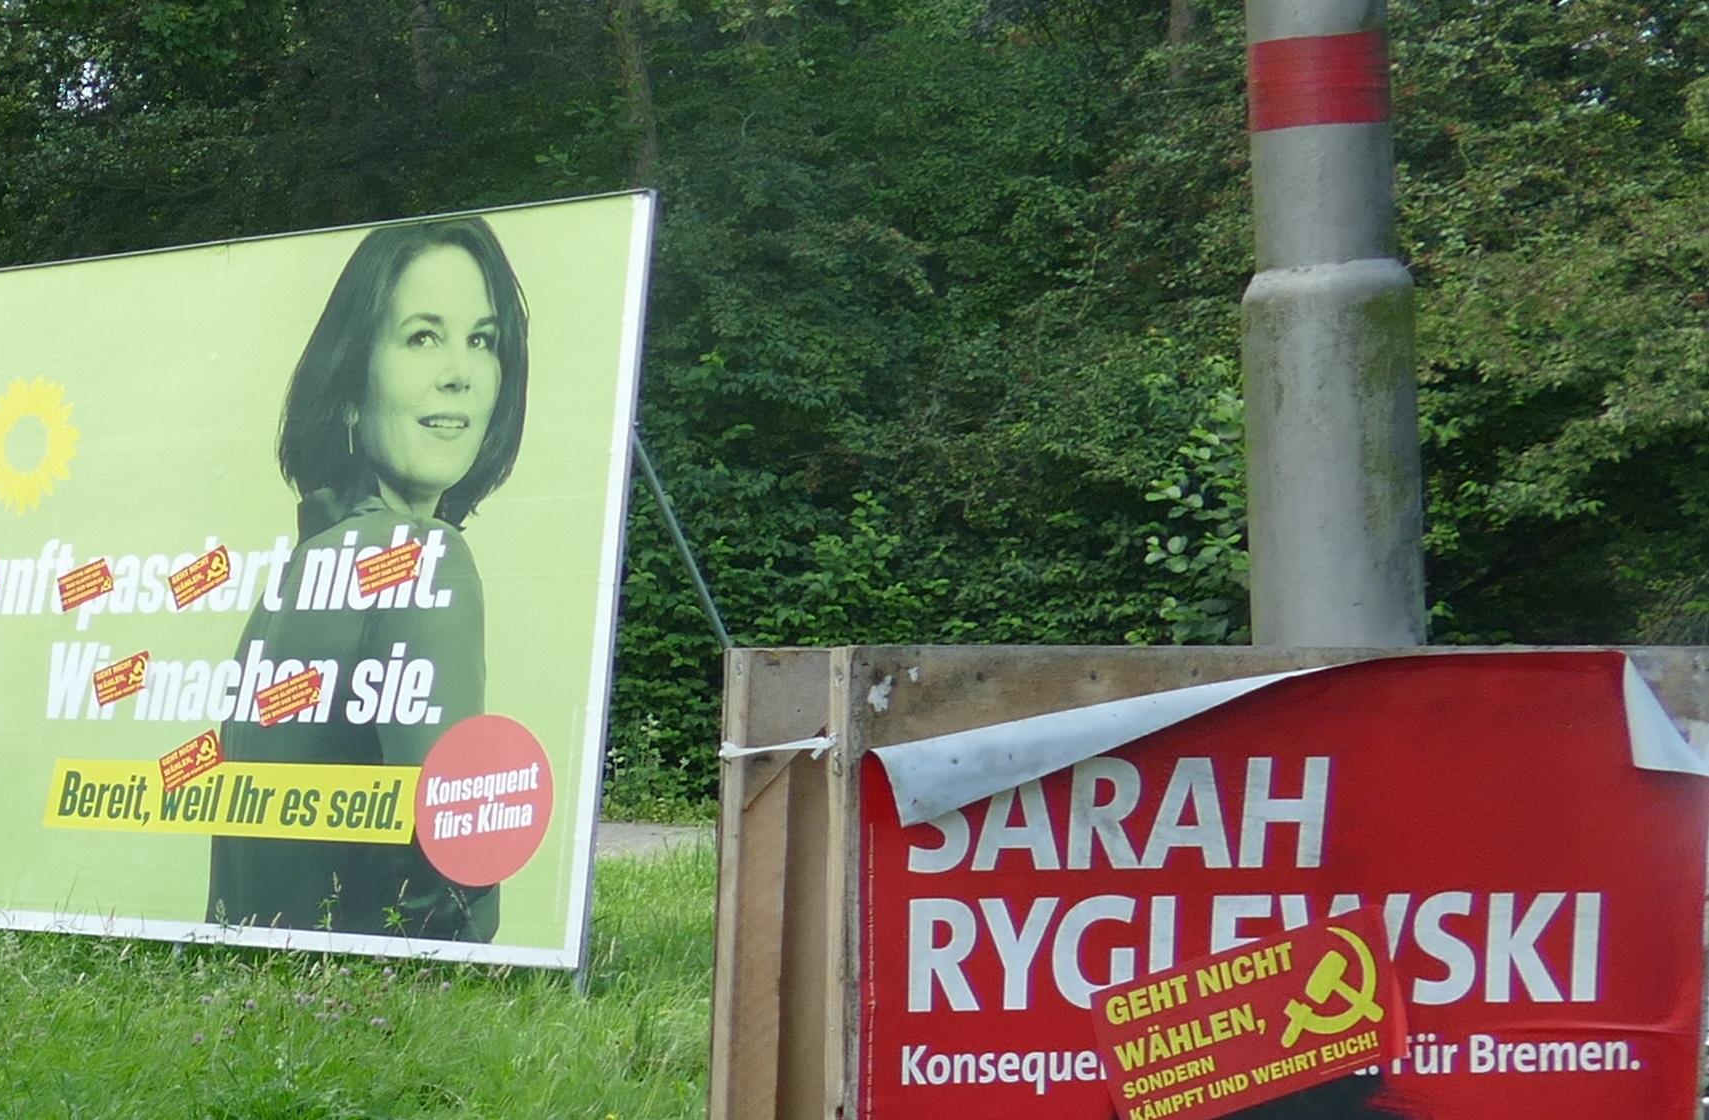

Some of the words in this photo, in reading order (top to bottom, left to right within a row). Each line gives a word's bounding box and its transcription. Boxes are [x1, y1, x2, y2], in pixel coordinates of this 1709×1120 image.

[46, 641, 118, 720] Wi
[345, 641, 443, 725] sie.
[58, 770, 151, 826] Bereit,
[160, 775, 224, 822] weil
[226, 775, 276, 825] Ihr
[279, 787, 321, 827] es
[326, 779, 404, 831] seid.
[425, 762, 540, 807] Konsequent
[907, 756, 1331, 873] SARAH
[433, 810, 473, 840] fürs
[477, 802, 533, 833] Klima
[907, 891, 1602, 1013] RYGLESKI
[1106, 974, 1189, 1025] GEHT
[1195, 941, 1293, 997] NICHT
[901, 1045, 1108, 1094] Konseque
[1114, 1003, 1267, 1072] WÄHLEN,
[1208, 1073, 1249, 1100] UND
[1251, 1051, 1318, 1086] WEHRT
[1321, 1031, 1379, 1064] EUCH!
[1469, 1034, 1641, 1075] Bremen.
[1123, 1056, 1216, 1099] SONDERN
